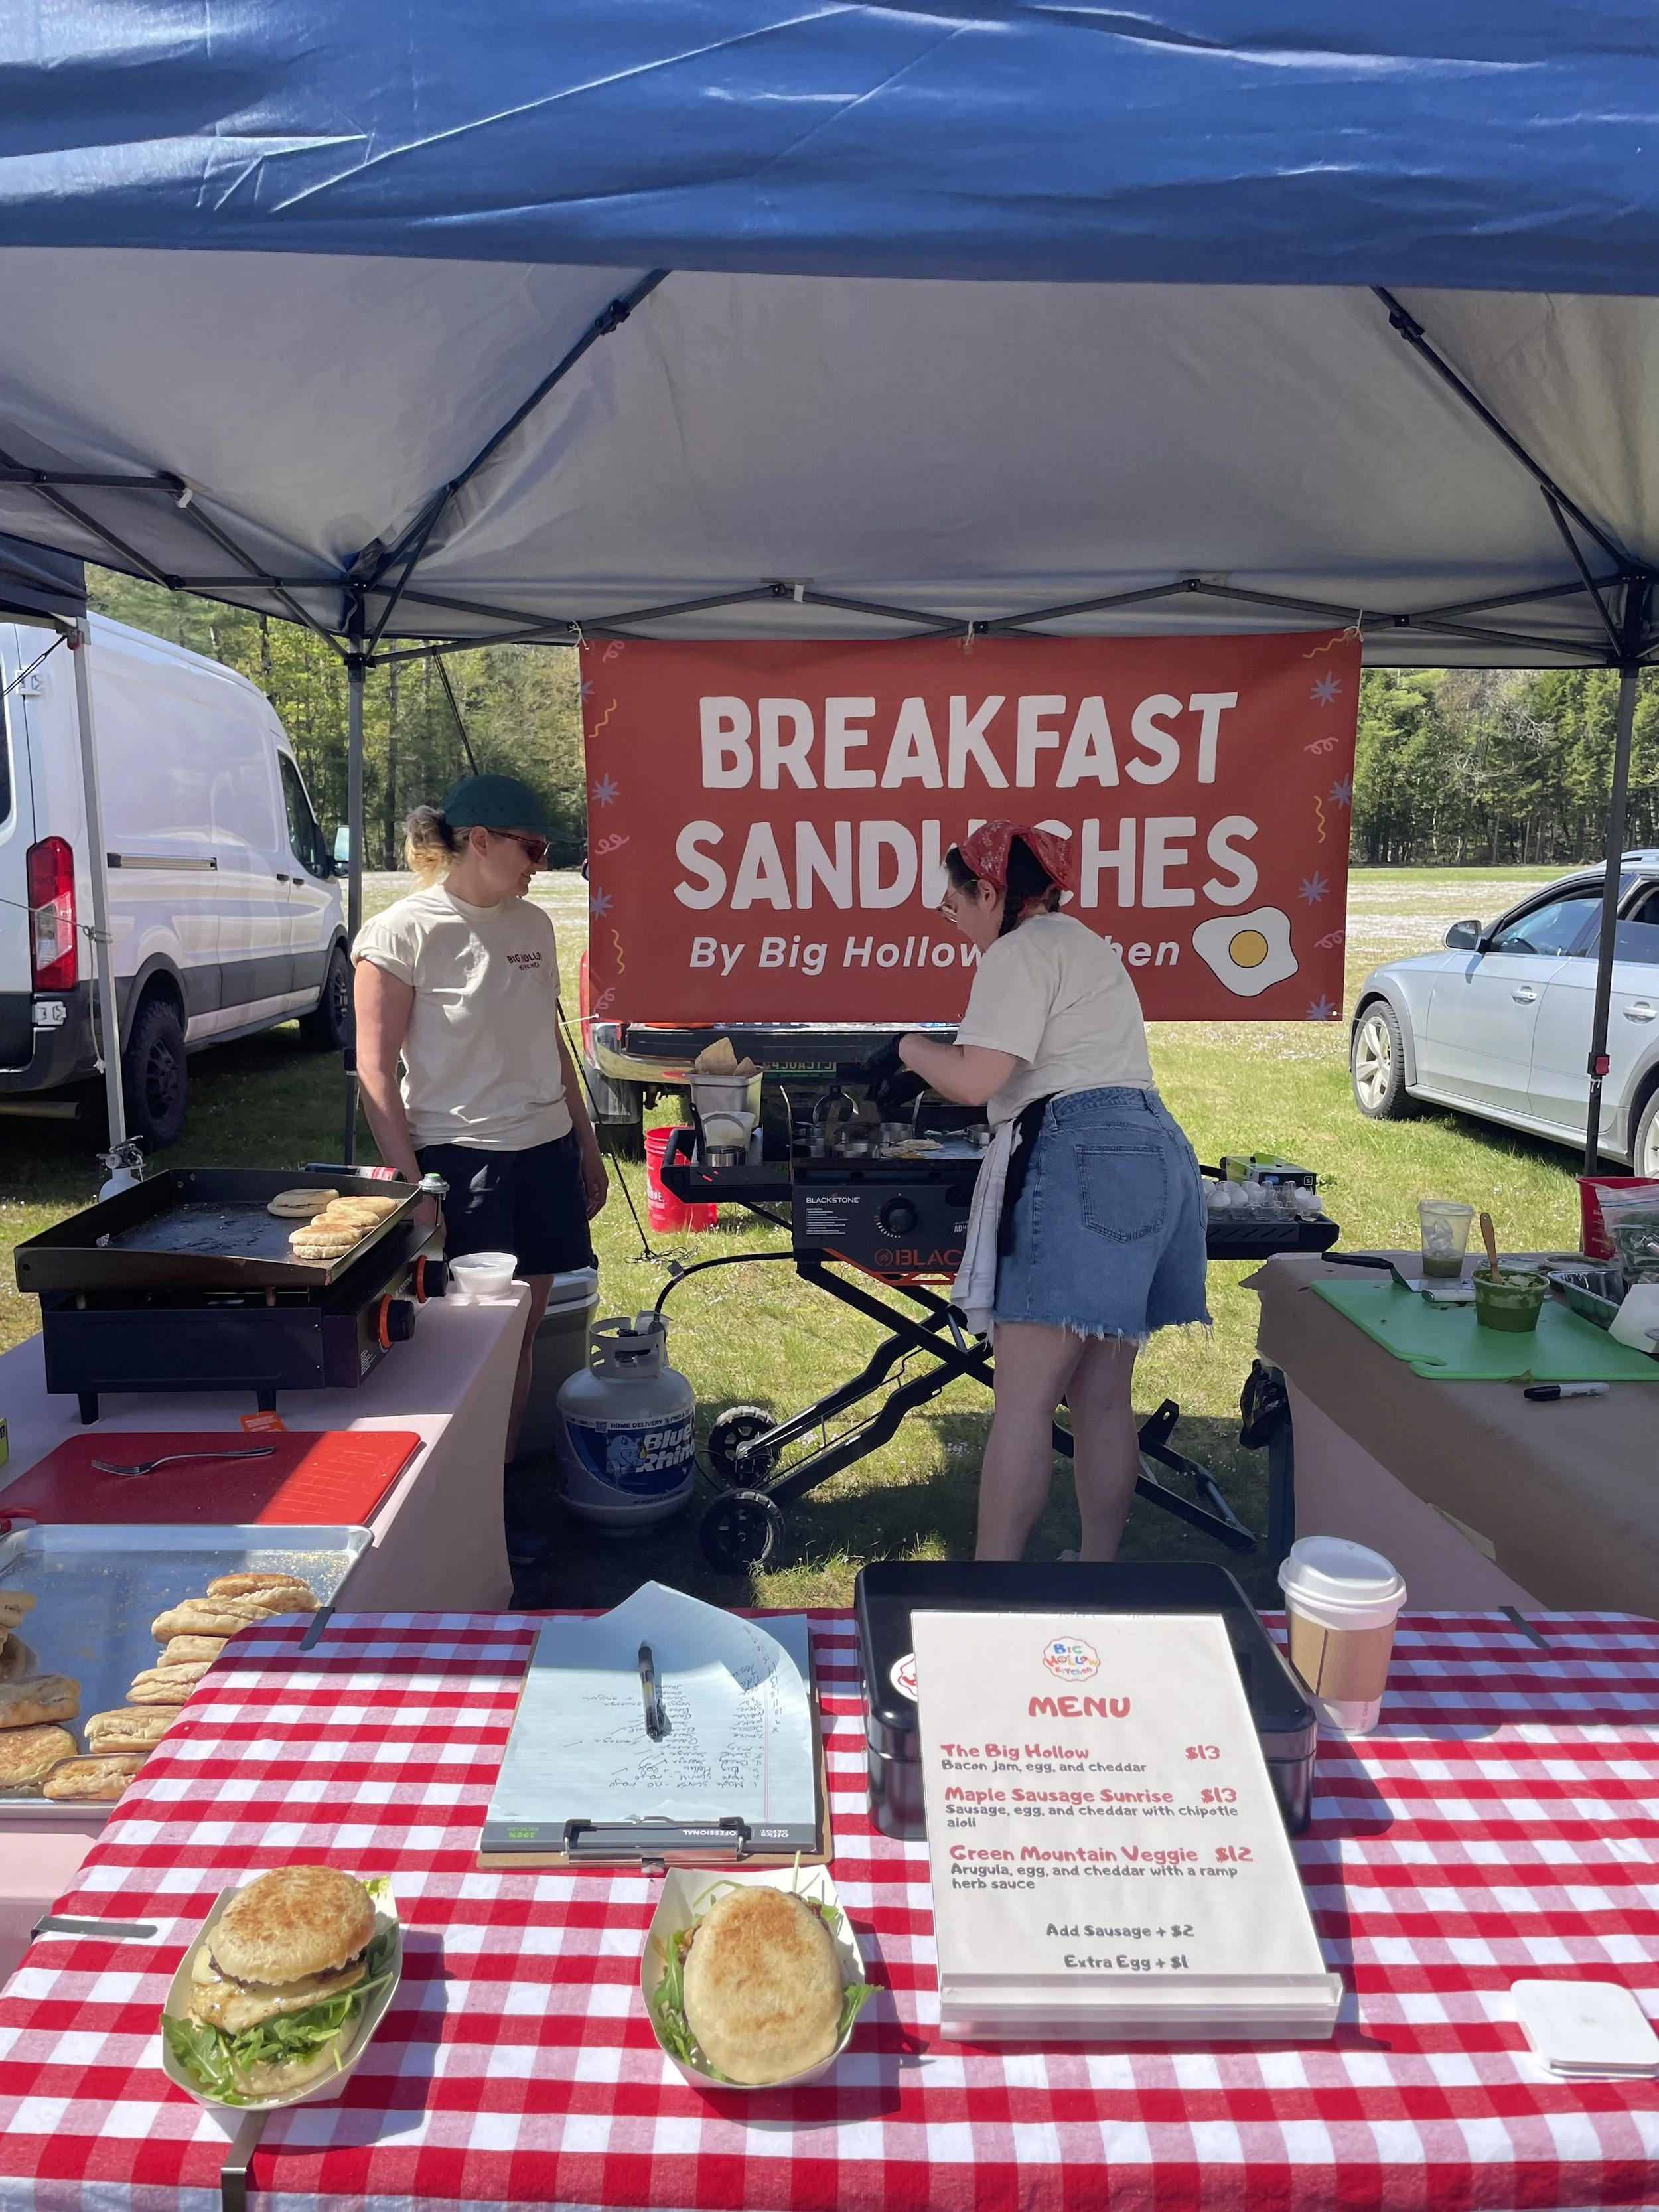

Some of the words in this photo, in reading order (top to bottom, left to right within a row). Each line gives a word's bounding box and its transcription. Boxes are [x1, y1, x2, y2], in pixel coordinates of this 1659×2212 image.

[699, 692, 1238, 790] BREAKFAST
[507, 954, 521, 964] BIG
[689, 936, 745, 976] By
[758, 935, 828, 976] Big
[632, 1420, 663, 1428] DELIVERY
[643, 1423, 693, 1451] Blue
[1029, 1696, 1130, 1718] MENU
[940, 1744, 979, 1757] The
[985, 1744, 1019, 1761] Big
[1025, 1744, 1088, 1758] Hollow
[1186, 1745, 1220, 1760] $13
[942, 1760, 987, 1770] Bacon
[1026, 1764, 1055, 1773] egg,
[1060, 1763, 1084, 1771] and
[1089, 1763, 1146, 1772] cheddar
[945, 1787, 1005, 1805] Maple
[1012, 1789, 1094, 1805] Sausage
[1100, 1789, 1173, 1802] Sunrise
[1201, 1787, 1236, 1803] $13
[946, 1805, 1010, 1816] Sausage,
[1014, 1807, 1045, 1816] egg,
[1048, 1806, 1074, 1815] and
[1079, 1806, 1137, 1816] cheddar
[1143, 1806, 1174, 1816] with
[1179, 1806, 1238, 1818] chipotle
[948, 1818, 976, 1827] aioli
[950, 1845, 1014, 1860] Green
[1021, 1846, 1116, 1861] Mountain
[1121, 1846, 1198, 1864] Veggie
[1216, 1846, 1253, 1863] $12
[951, 1863, 1013, 1877] Arugula,
[1017, 1867, 1049, 1878] egg,
[1052, 1865, 1080, 1876] and
[1084, 1865, 1145, 1876] cheddar
[1150, 1866, 1184, 1876] with
[1200, 1868, 1237, 1878] ramp
[952, 1878, 987, 1889] herb
[1047, 1923, 1080, 1936] Add
[1084, 1925, 1151, 1939] Sausage
[1171, 1925, 1194, 1937] $2
[1064, 1955, 1112, 1968] Extra
[1116, 1955, 1151, 1971] Egg
[1171, 1955, 1188, 1969] $1
